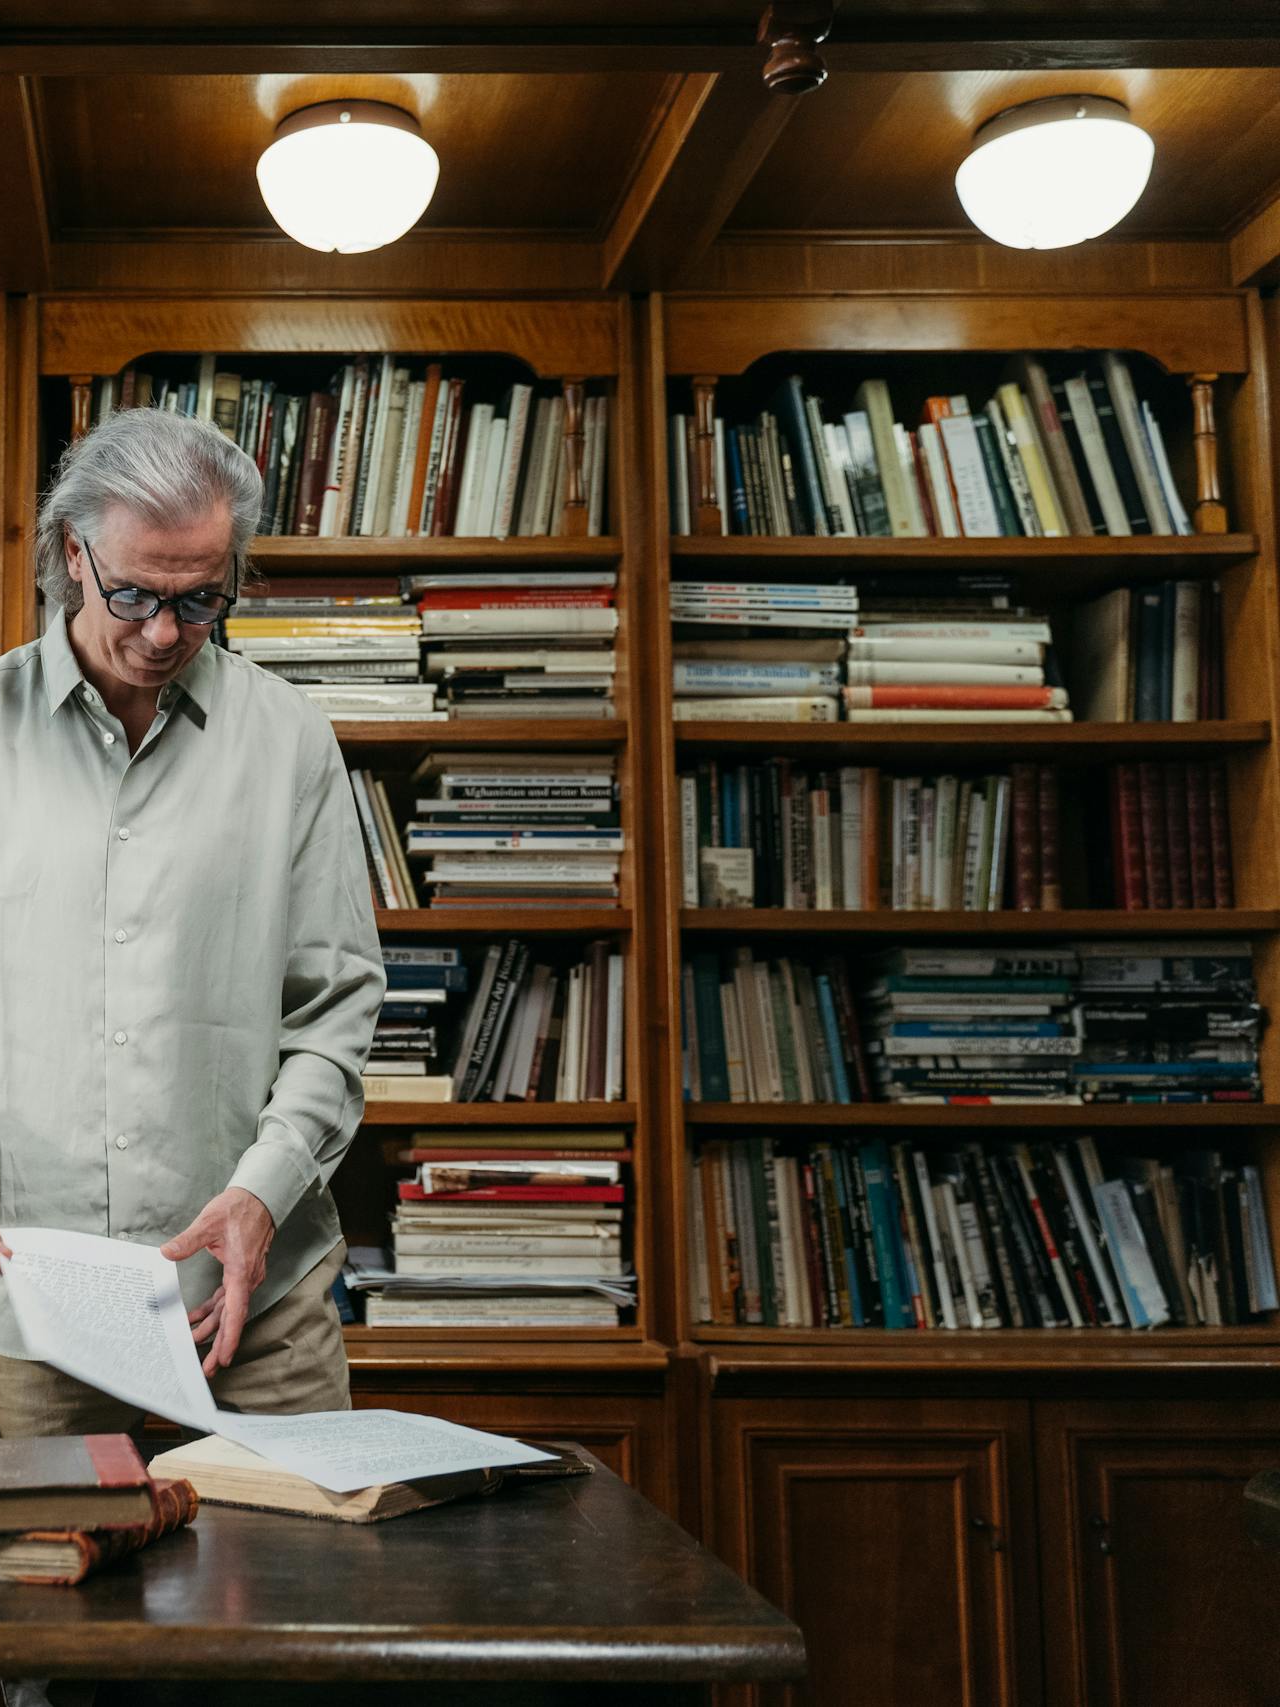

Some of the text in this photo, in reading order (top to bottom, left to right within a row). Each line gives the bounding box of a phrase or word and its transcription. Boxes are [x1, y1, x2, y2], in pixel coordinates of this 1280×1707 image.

[463, 785, 612, 799] Afghanistan und seine Kunst
[1017, 1038, 1075, 1053] SCARPA
